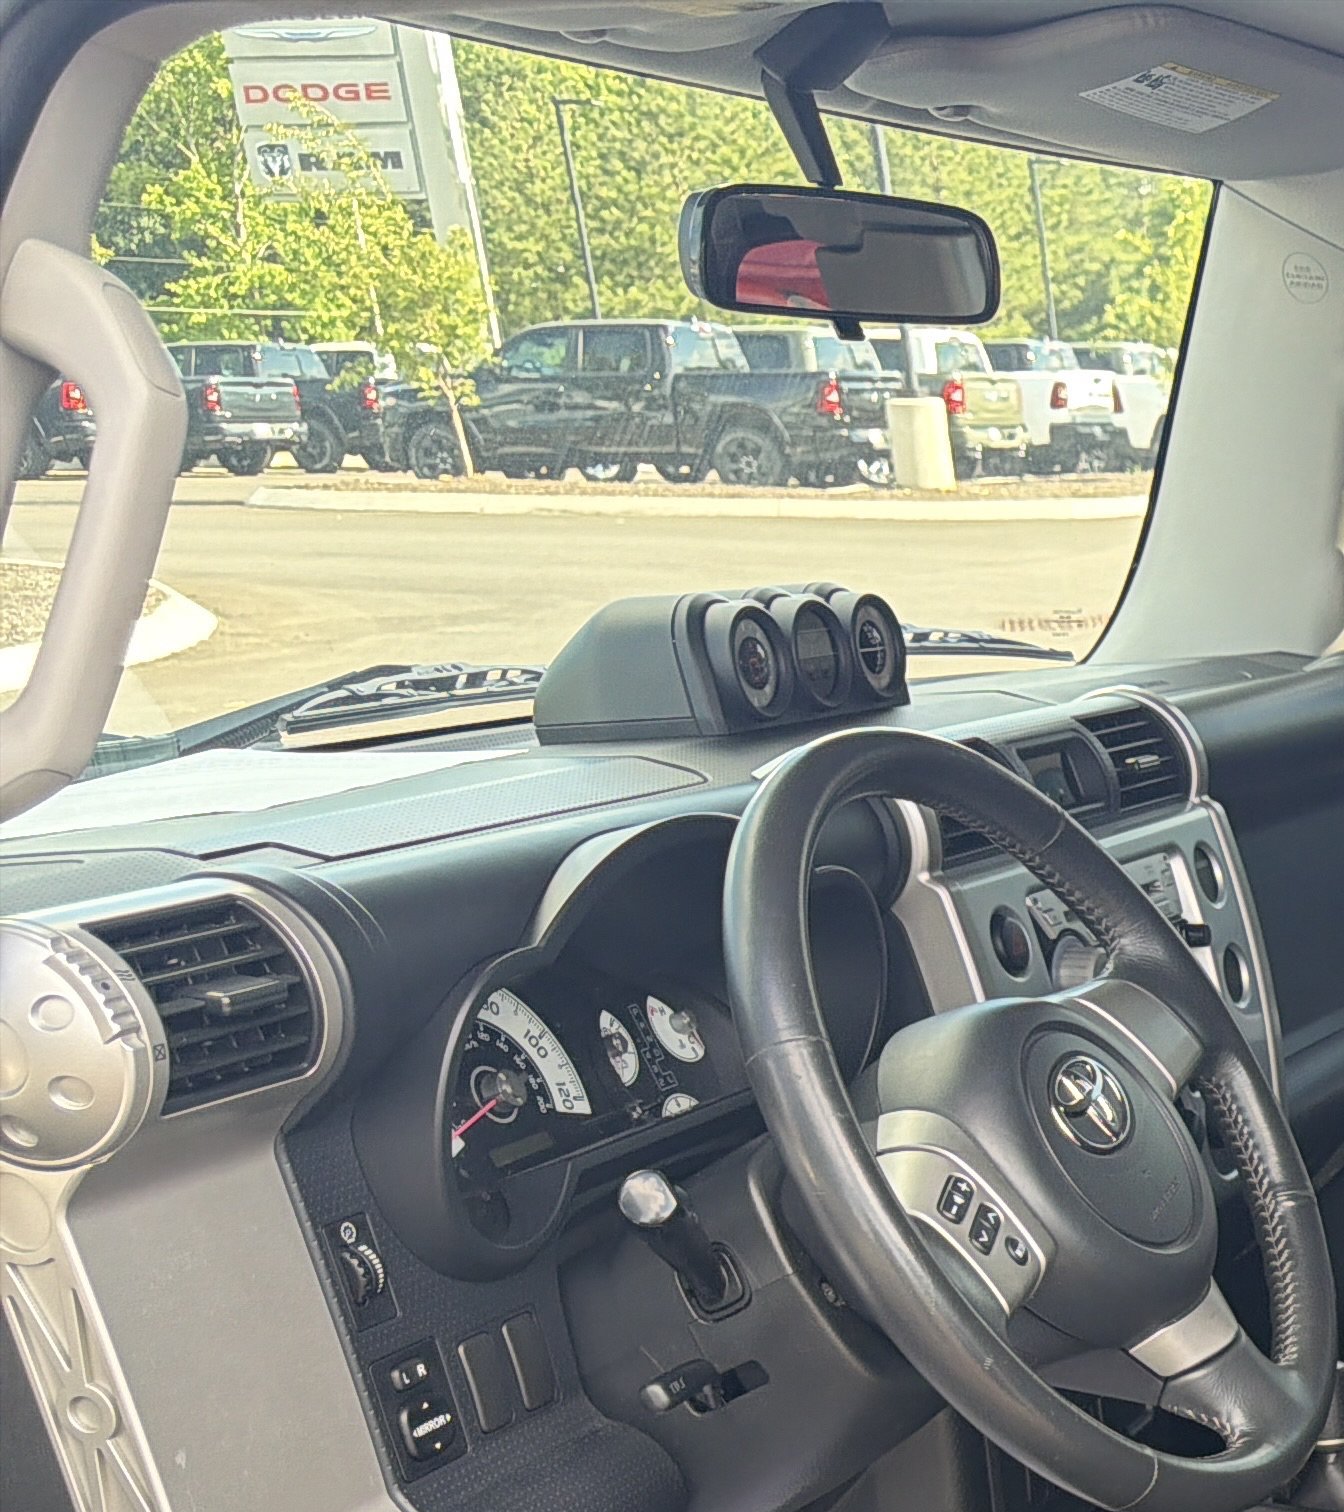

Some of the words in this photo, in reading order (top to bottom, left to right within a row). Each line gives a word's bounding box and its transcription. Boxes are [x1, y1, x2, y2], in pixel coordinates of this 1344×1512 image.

[243, 82, 391, 104] DODGE
[523, 1029, 549, 1059] 100
[555, 1081, 575, 1111] 120
[416, 1363, 428, 1377] R
